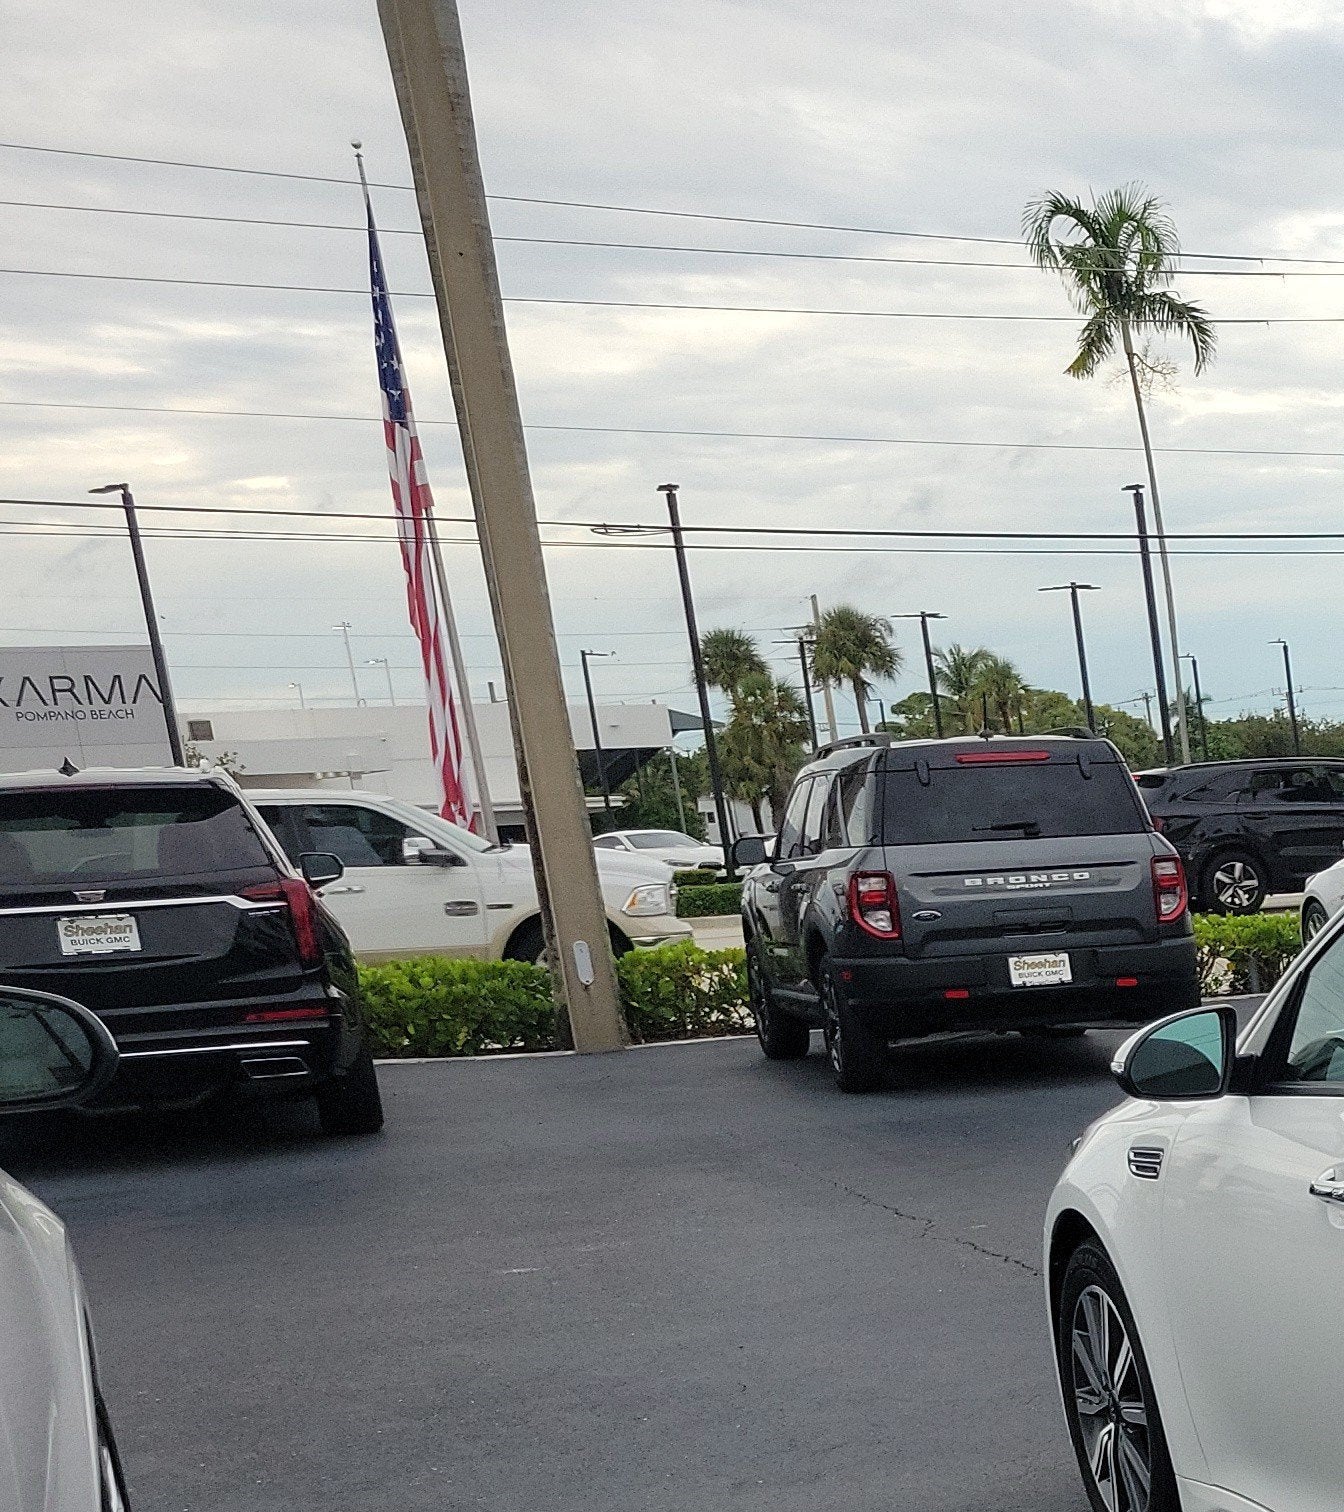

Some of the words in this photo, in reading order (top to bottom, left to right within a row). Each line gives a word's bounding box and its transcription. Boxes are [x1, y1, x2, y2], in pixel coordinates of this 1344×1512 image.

[16, 709, 87, 722] POMPANO
[90, 708, 135, 720] BEACH
[964, 872, 1090, 887] BRONCO
[1006, 882, 1052, 890] SPORT
[63, 922, 133, 938] Sheehan
[70, 937, 104, 946] BUICK
[106, 936, 131, 944] GMC
[1013, 958, 1066, 971] Sheehan
[1045, 969, 1064, 977] GMC
